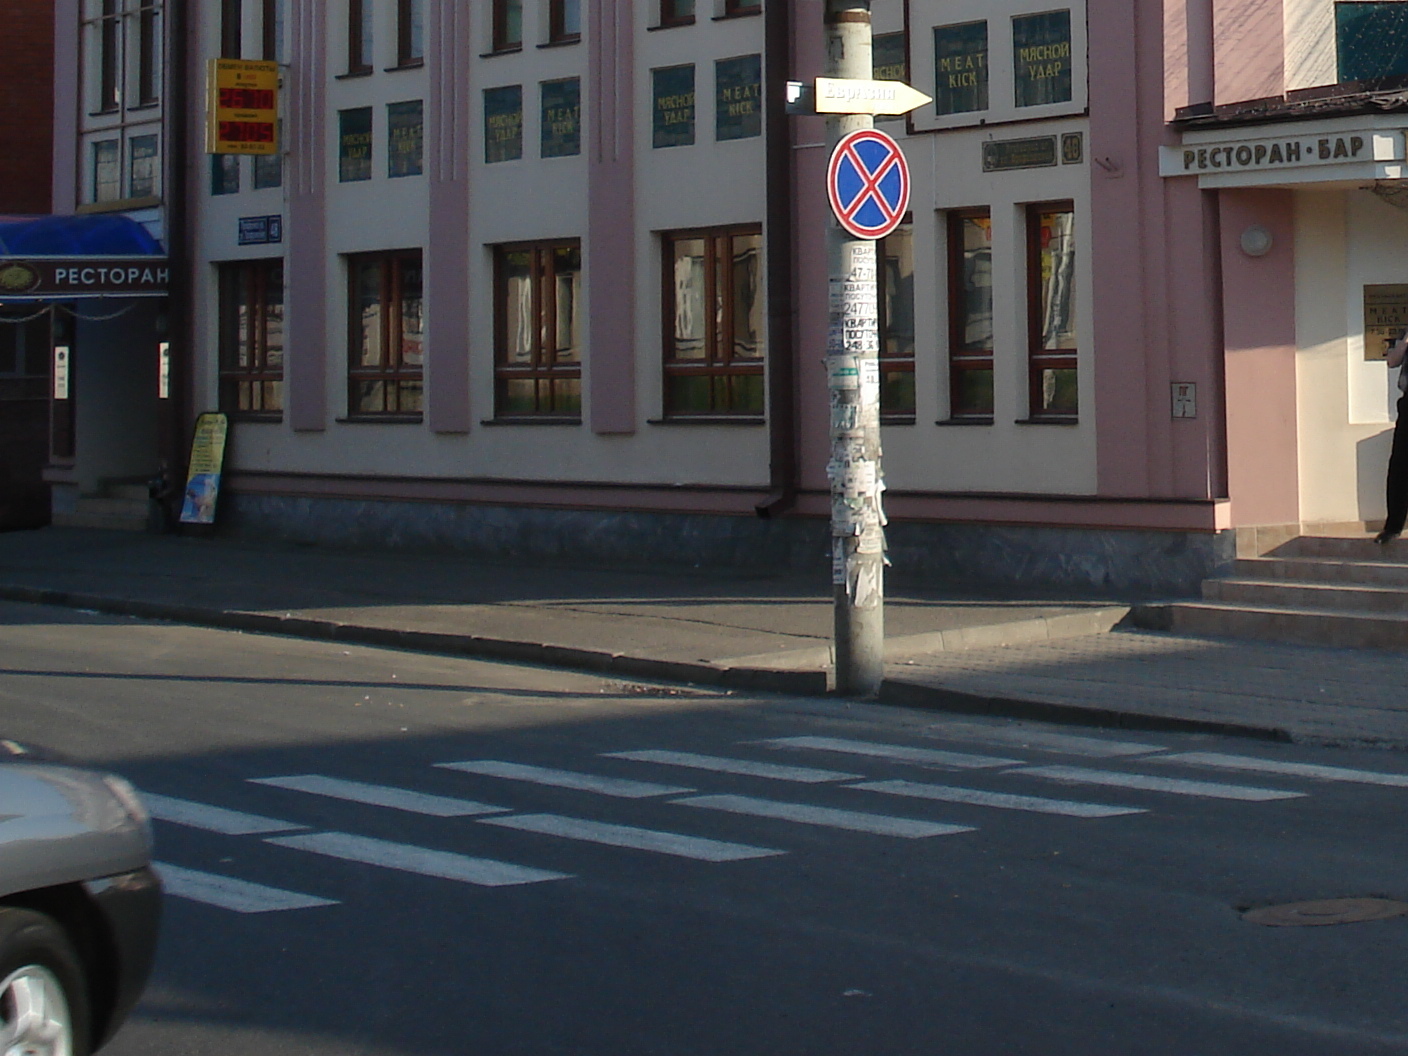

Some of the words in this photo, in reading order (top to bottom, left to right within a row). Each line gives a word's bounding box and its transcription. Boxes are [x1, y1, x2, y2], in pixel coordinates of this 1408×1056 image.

[1018, 41, 1070, 63] МЯСНОЙ
[941, 53, 984, 72] MEAT
[1029, 61, 1062, 82] УДАР
[949, 71, 977, 89] KICK
[722, 83, 760, 101] MEAT
[1182, 142, 1301, 170] РЕСТОРАН
[1317, 136, 1364, 161] БАР
[55, 268, 169, 285] РЕСТОРАН
[1369, 306, 1407, 315] MEAT
